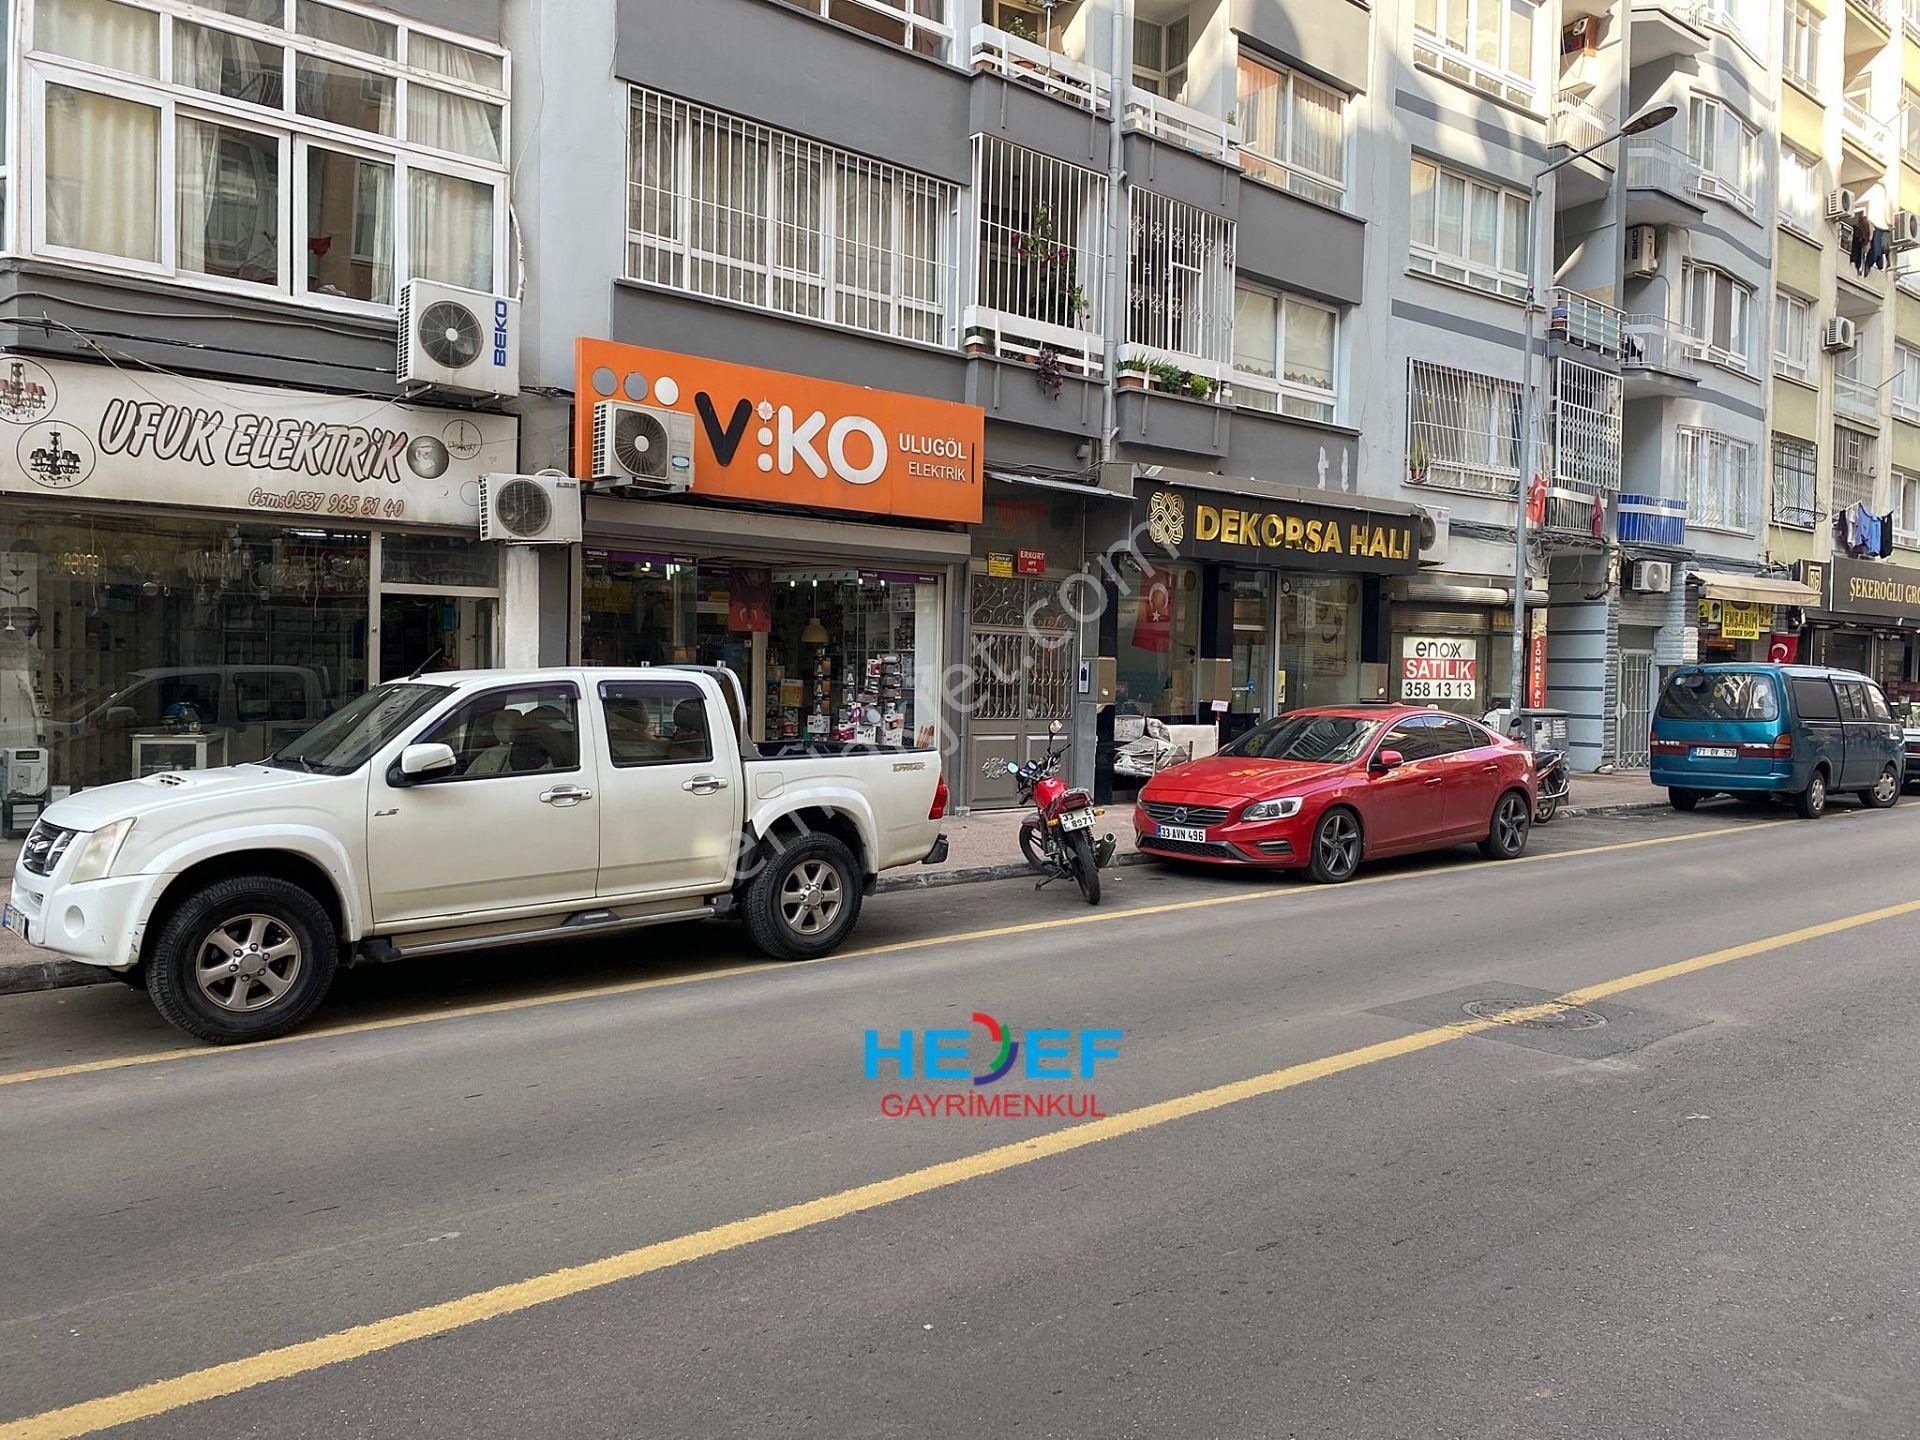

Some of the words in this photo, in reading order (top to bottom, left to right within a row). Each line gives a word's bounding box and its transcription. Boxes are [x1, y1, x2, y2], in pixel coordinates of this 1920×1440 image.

[494, 300, 507, 367] BEKO
[99, 398, 223, 466] UFUK
[899, 432, 967, 460] ULUGÖL
[327, 493, 359, 514] 965
[361, 496, 380, 516] 81
[383, 498, 404, 518] 40
[1195, 504, 1343, 554] DEKORSA
[1350, 524, 1411, 560] HALI
[1849, 576, 1904, 603] ŞEKEROĞLU
[1405, 660, 1472, 679] SATILIK
[1405, 682, 1431, 697] 358
[1435, 682, 1451, 697] 13
[1456, 682, 1472, 698] 13
[1084, 808, 1091, 816] E
[1161, 827, 1170, 838] 33
[1188, 830, 1204, 841] 496
